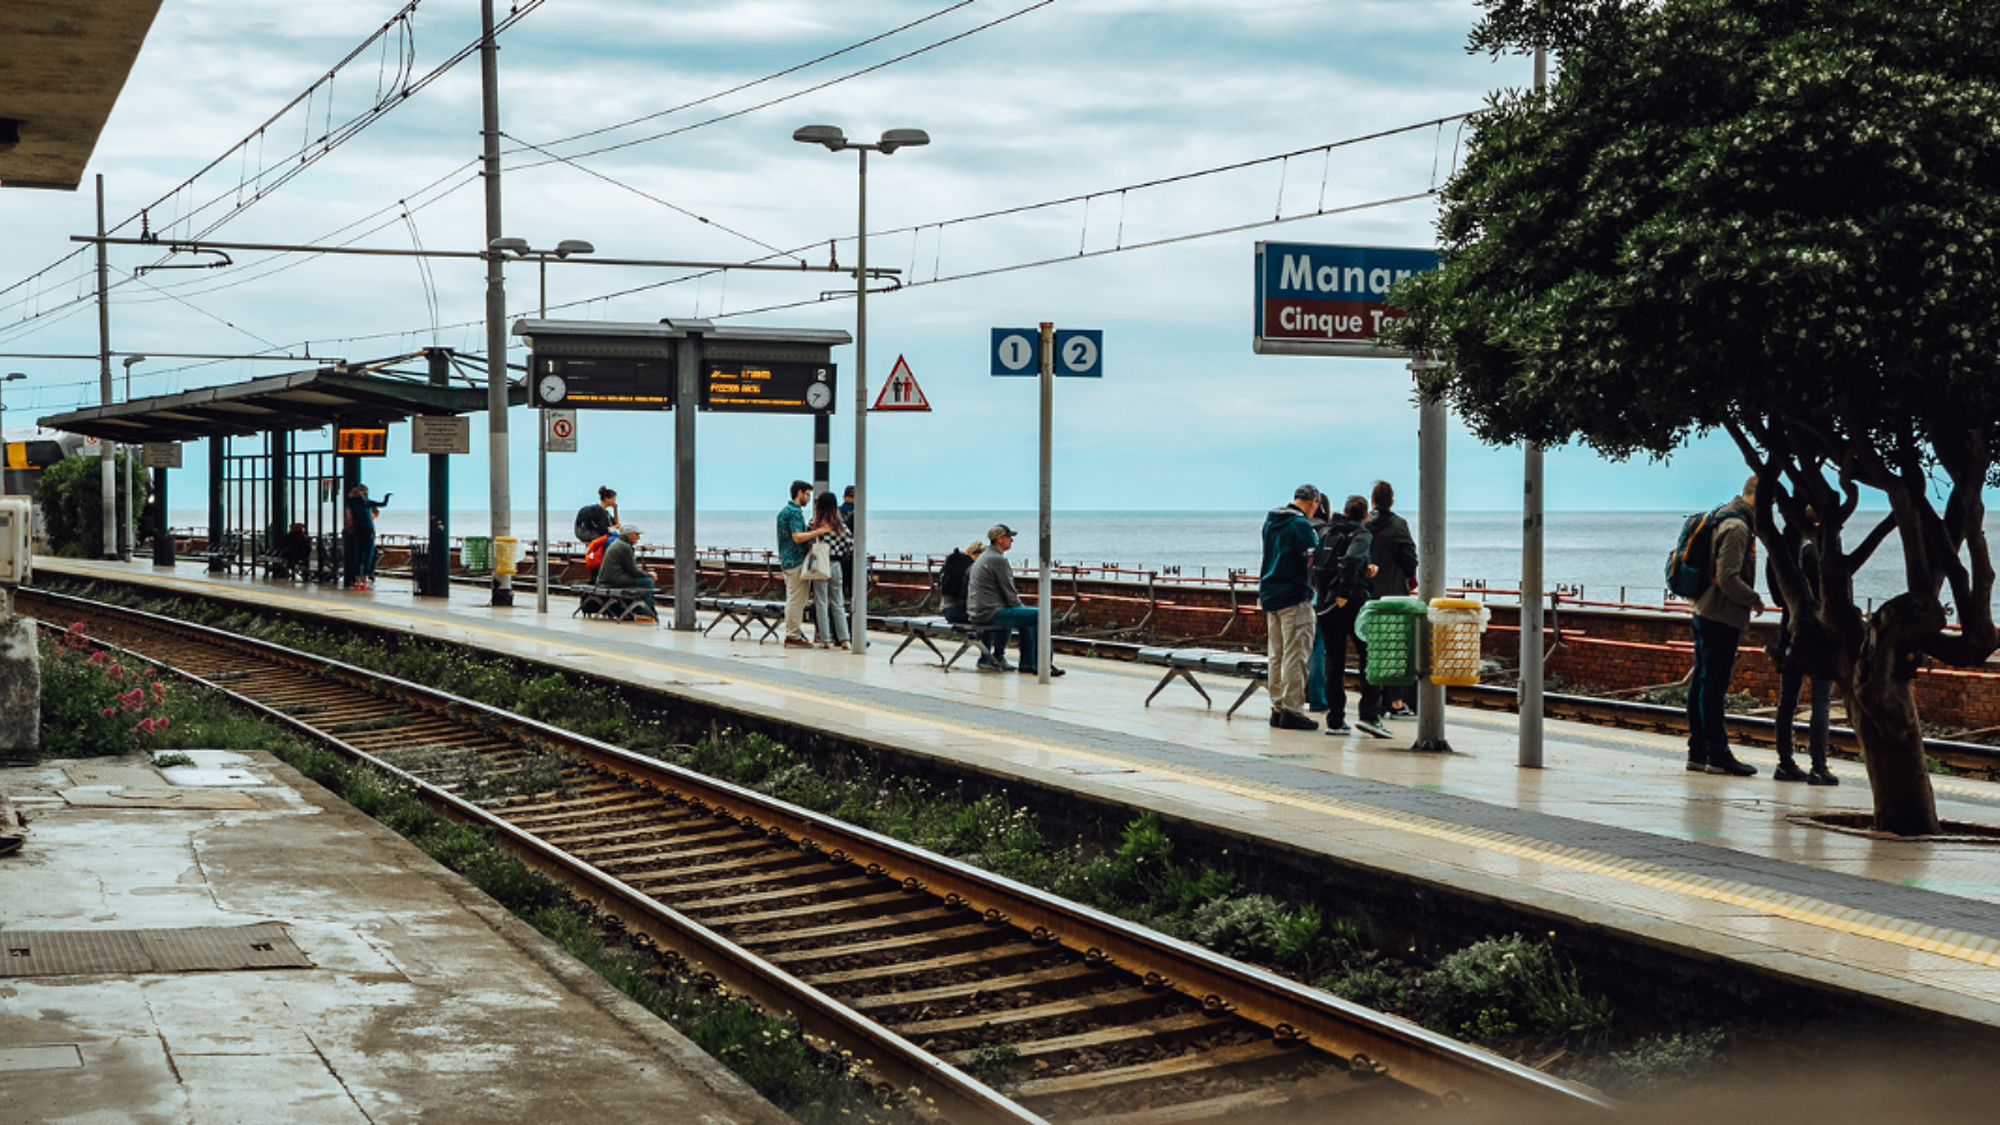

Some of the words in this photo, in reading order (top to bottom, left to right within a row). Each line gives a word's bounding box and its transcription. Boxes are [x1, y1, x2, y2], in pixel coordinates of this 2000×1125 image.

[1279, 254, 1445, 295] Manar
[1280, 306, 1363, 338] Cinque
[1011, 342, 1019, 363] 1
[1071, 342, 1088, 365] 2
[547, 360, 554, 373] 1
[817, 369, 826, 381] 2
